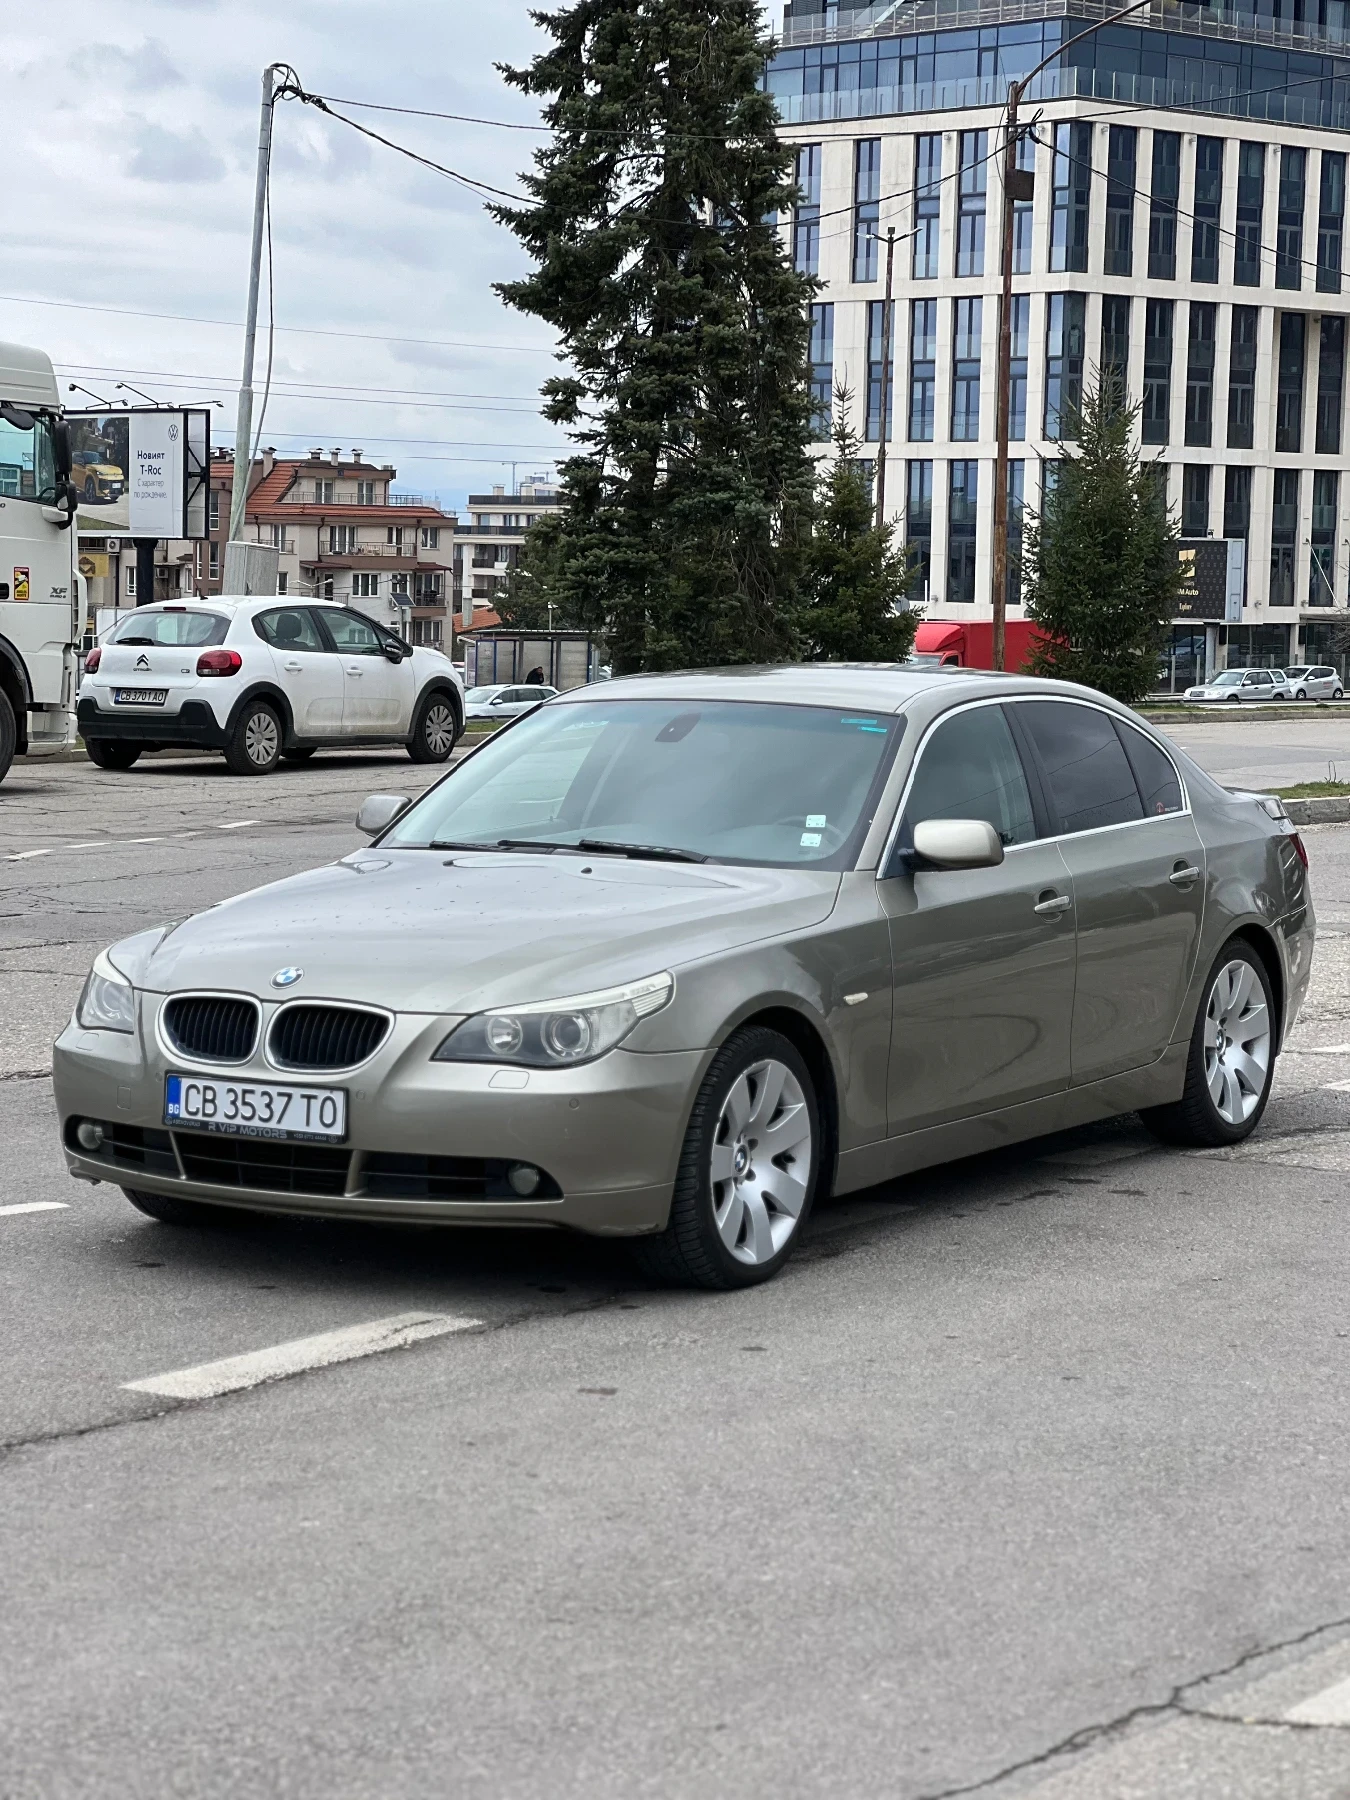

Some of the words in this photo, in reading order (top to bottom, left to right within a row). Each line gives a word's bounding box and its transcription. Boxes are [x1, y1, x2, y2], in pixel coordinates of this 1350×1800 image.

[137, 450, 165, 460] Новият
[140, 464, 162, 475] T-Roc
[142, 480, 164, 488] характер
[50, 586, 68, 594] XF
[121, 690, 131, 701] CB
[132, 691, 151, 701] 3701
[152, 691, 164, 702] AO
[168, 1104, 180, 1114] BG
[184, 1083, 218, 1118] CB
[223, 1087, 293, 1125] 3537
[300, 1093, 337, 1129] TO
[240, 1125, 288, 1139] MOTORS
